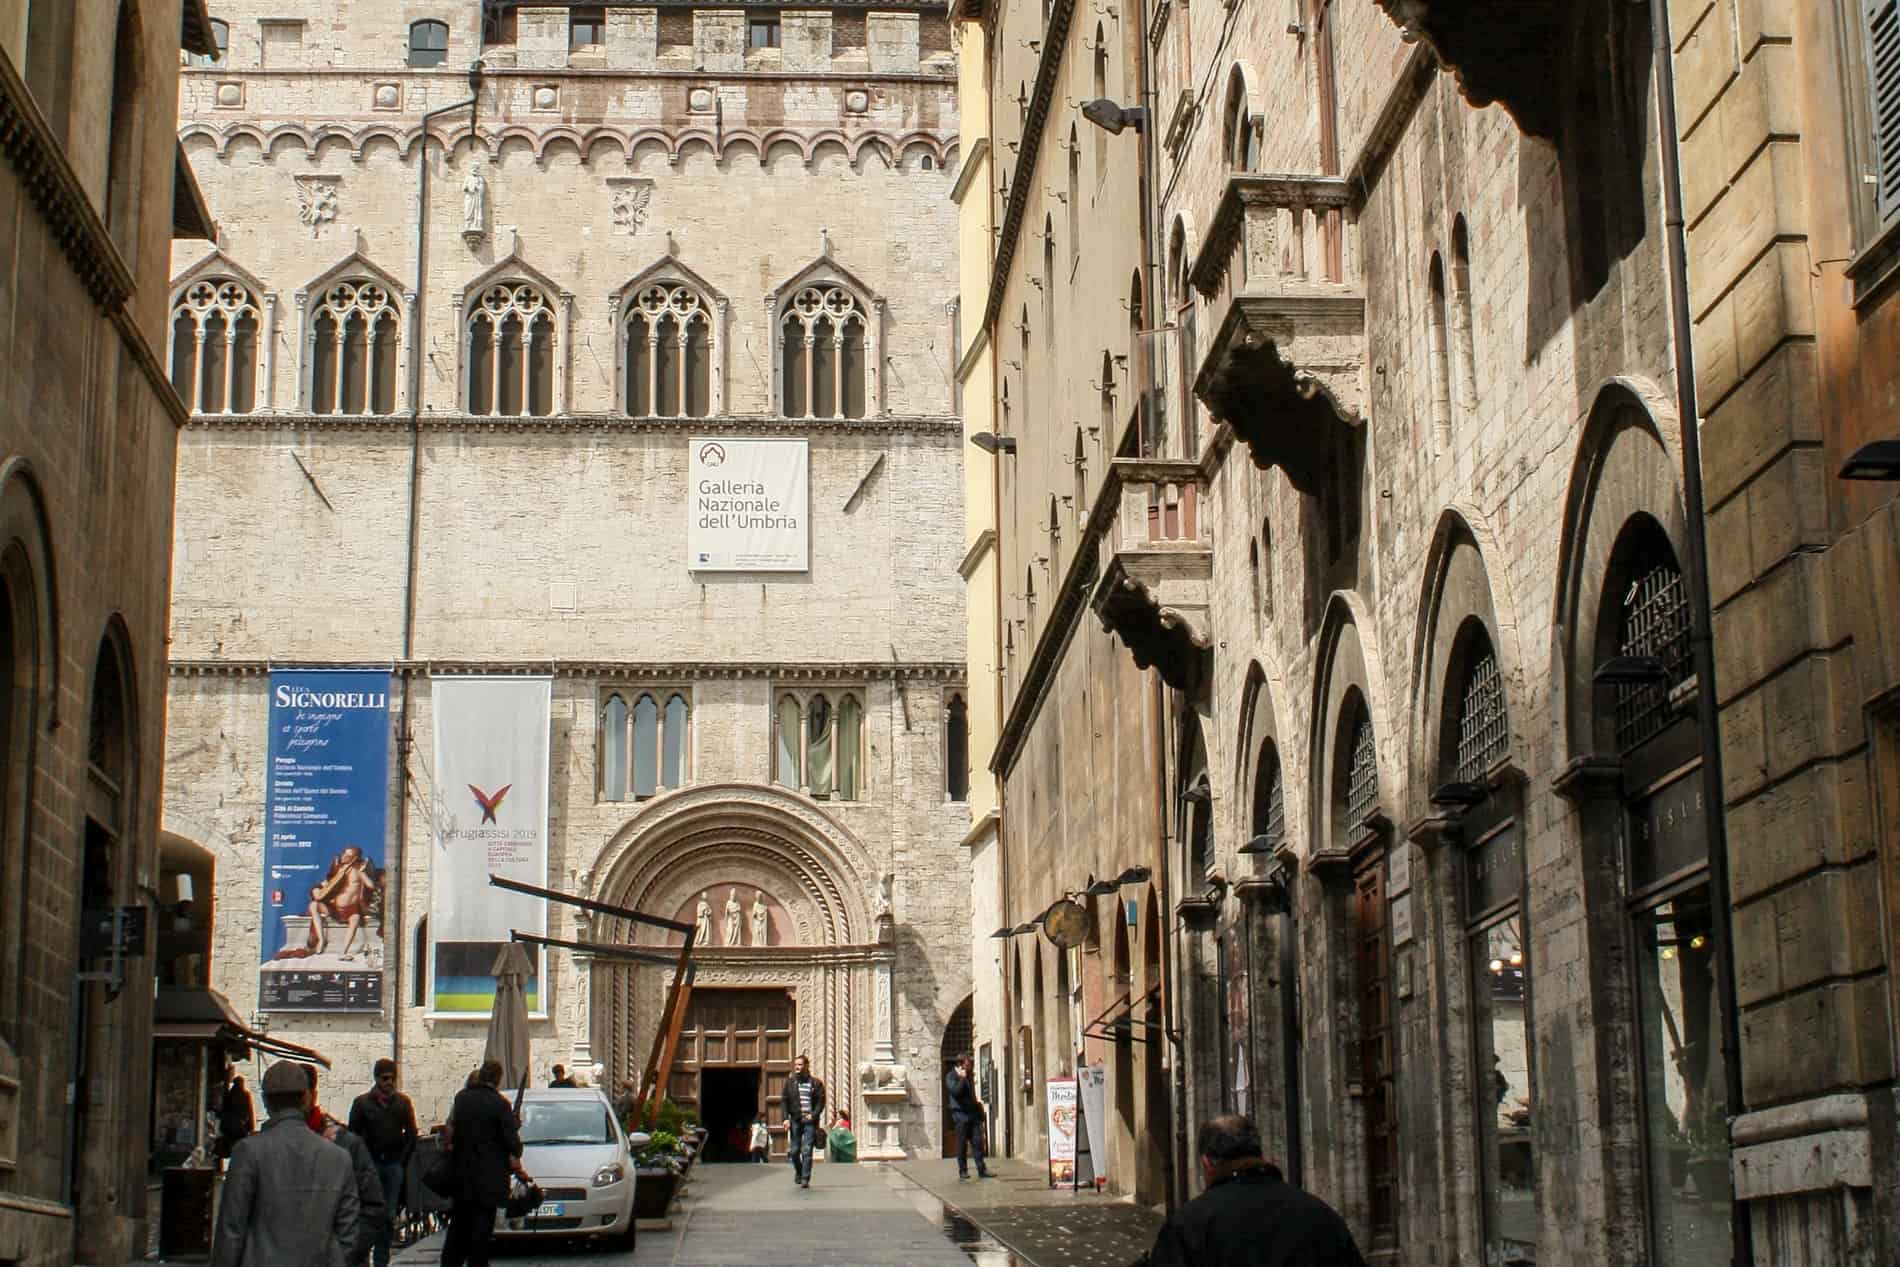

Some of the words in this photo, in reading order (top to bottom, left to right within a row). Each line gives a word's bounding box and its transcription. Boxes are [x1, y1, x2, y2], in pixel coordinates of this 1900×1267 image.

[699, 480, 764, 494] Galleria
[699, 497, 780, 512] Nazionale
[699, 514, 797, 529] dell'Umbria
[275, 685, 385, 708] SIGNORELLI
[1642, 792, 1704, 840] SISLE
[513, 830, 537, 840] 2019
